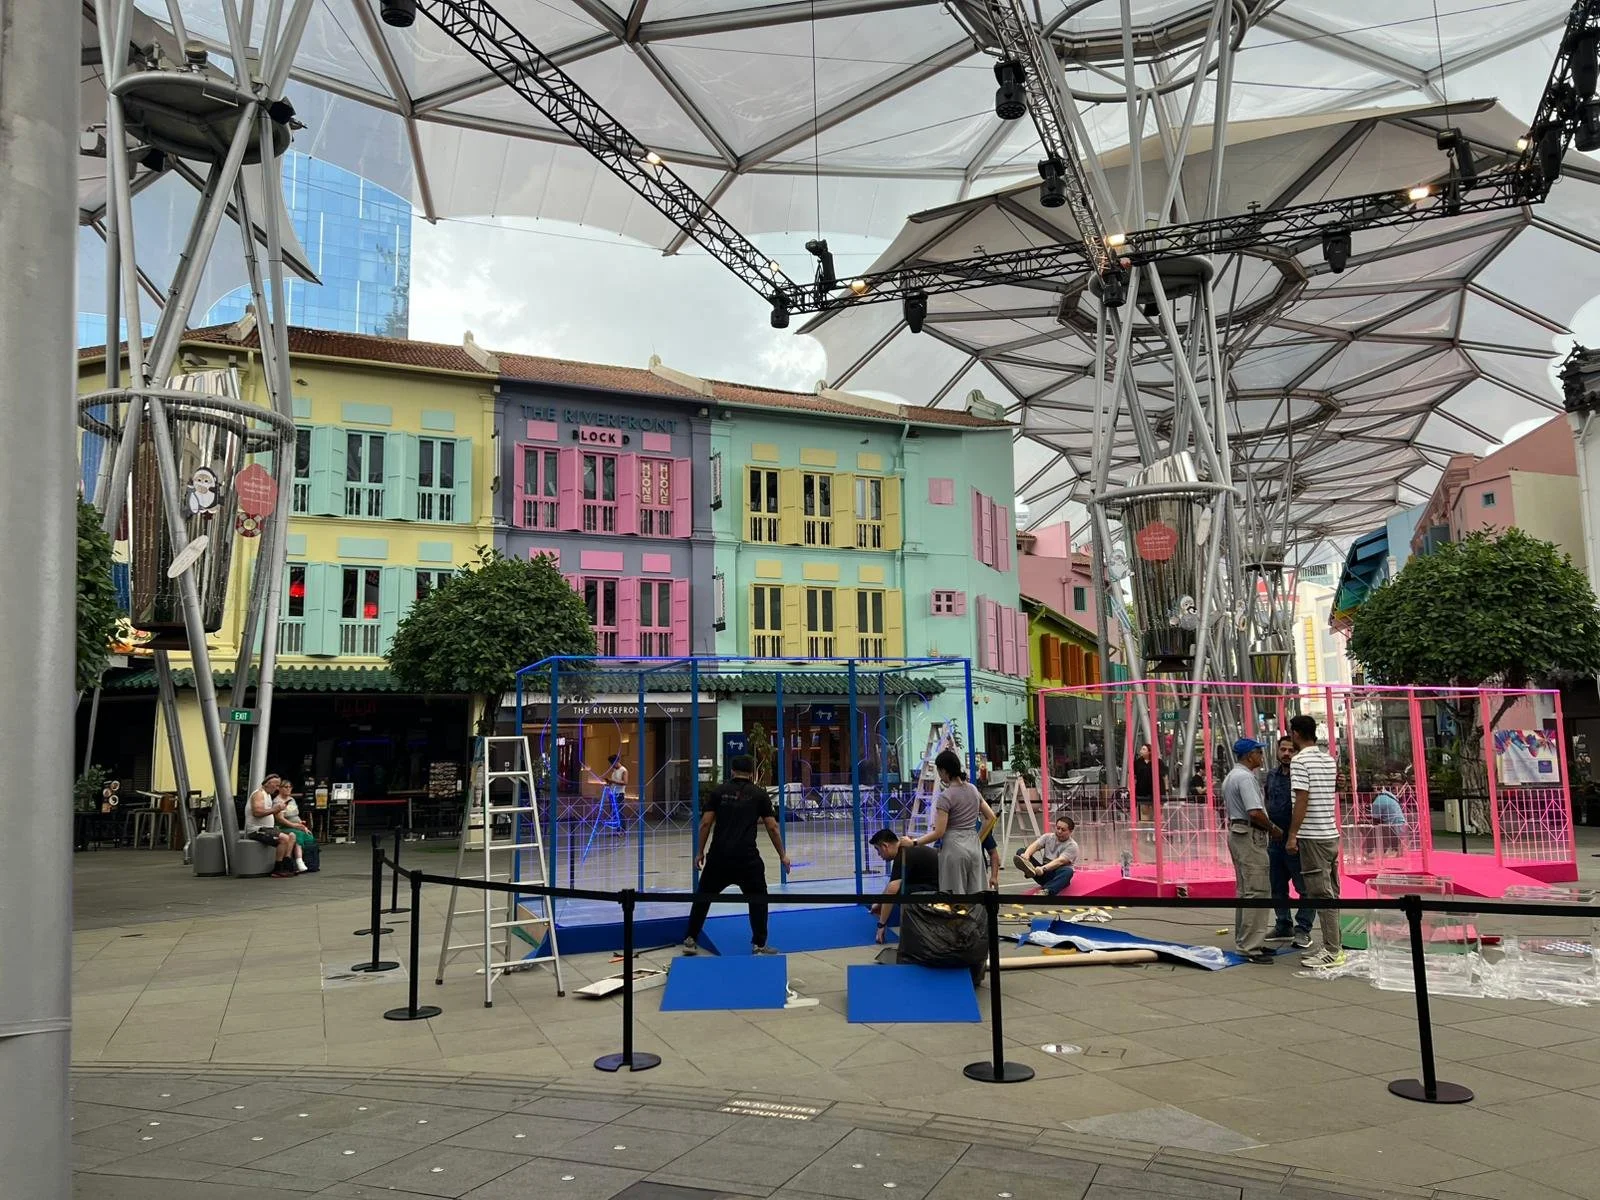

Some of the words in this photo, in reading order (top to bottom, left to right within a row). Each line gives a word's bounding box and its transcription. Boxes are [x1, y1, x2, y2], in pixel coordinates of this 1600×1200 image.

[521, 404, 556, 421] THE
[563, 408, 678, 434] RIVERFRONT
[572, 430, 616, 444] BLOCK
[622, 434, 630, 445] D
[642, 462, 651, 504] HUONE
[660, 463, 669, 505] HUONE
[235, 712, 247, 720] EXIT
[593, 706, 648, 714] RIVERFRONT
[741, 1108, 808, 1120] FOUNTAIN
